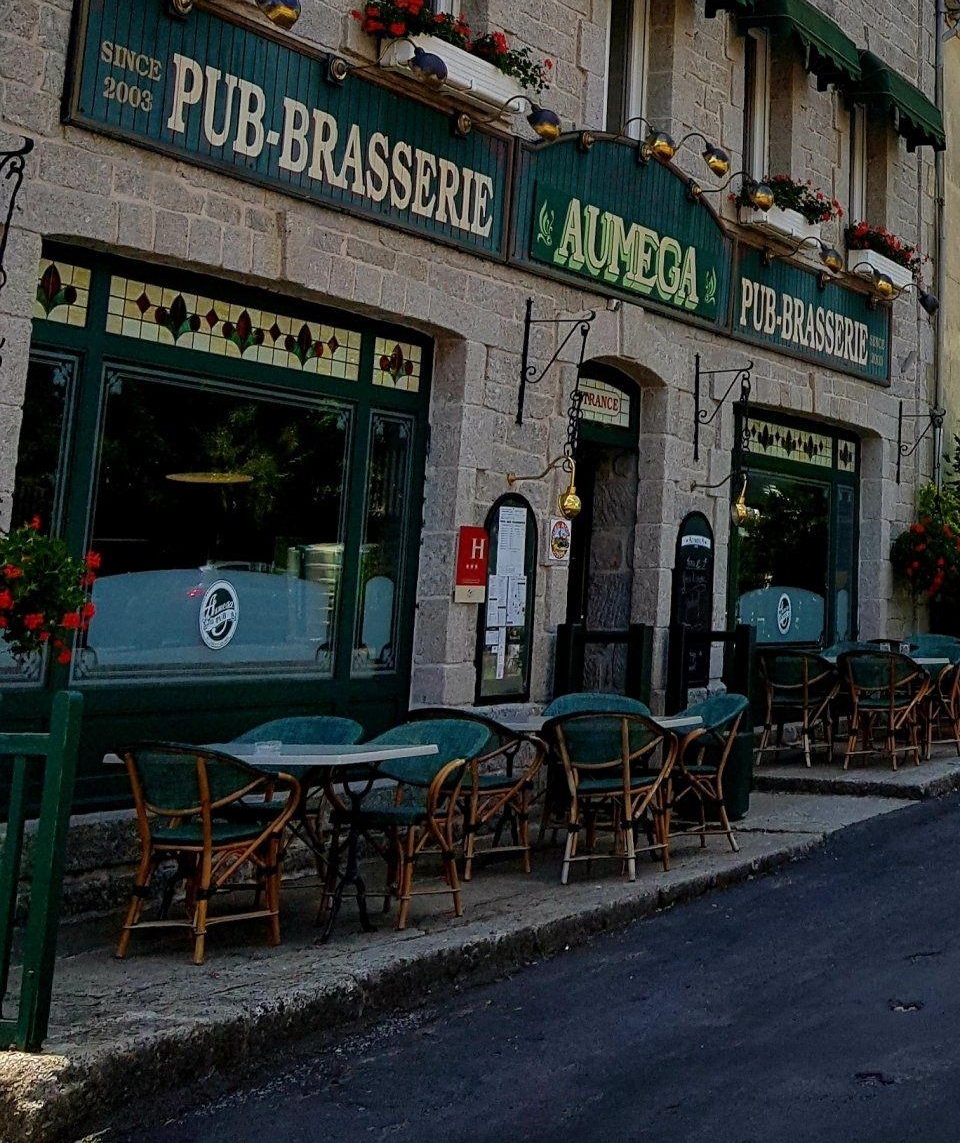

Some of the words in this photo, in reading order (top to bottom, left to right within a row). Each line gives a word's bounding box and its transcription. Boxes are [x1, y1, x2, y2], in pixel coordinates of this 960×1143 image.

[101, 41, 162, 82] SINCE
[103, 77, 153, 112] 2003
[167, 52, 494, 238] PUB-BRASSERIE
[554, 198, 700, 309] AUMEGA
[739, 277, 870, 366] PUB-BRASSERIE
[580, 391, 619, 411] TRANCE
[471, 538, 485, 559] H
